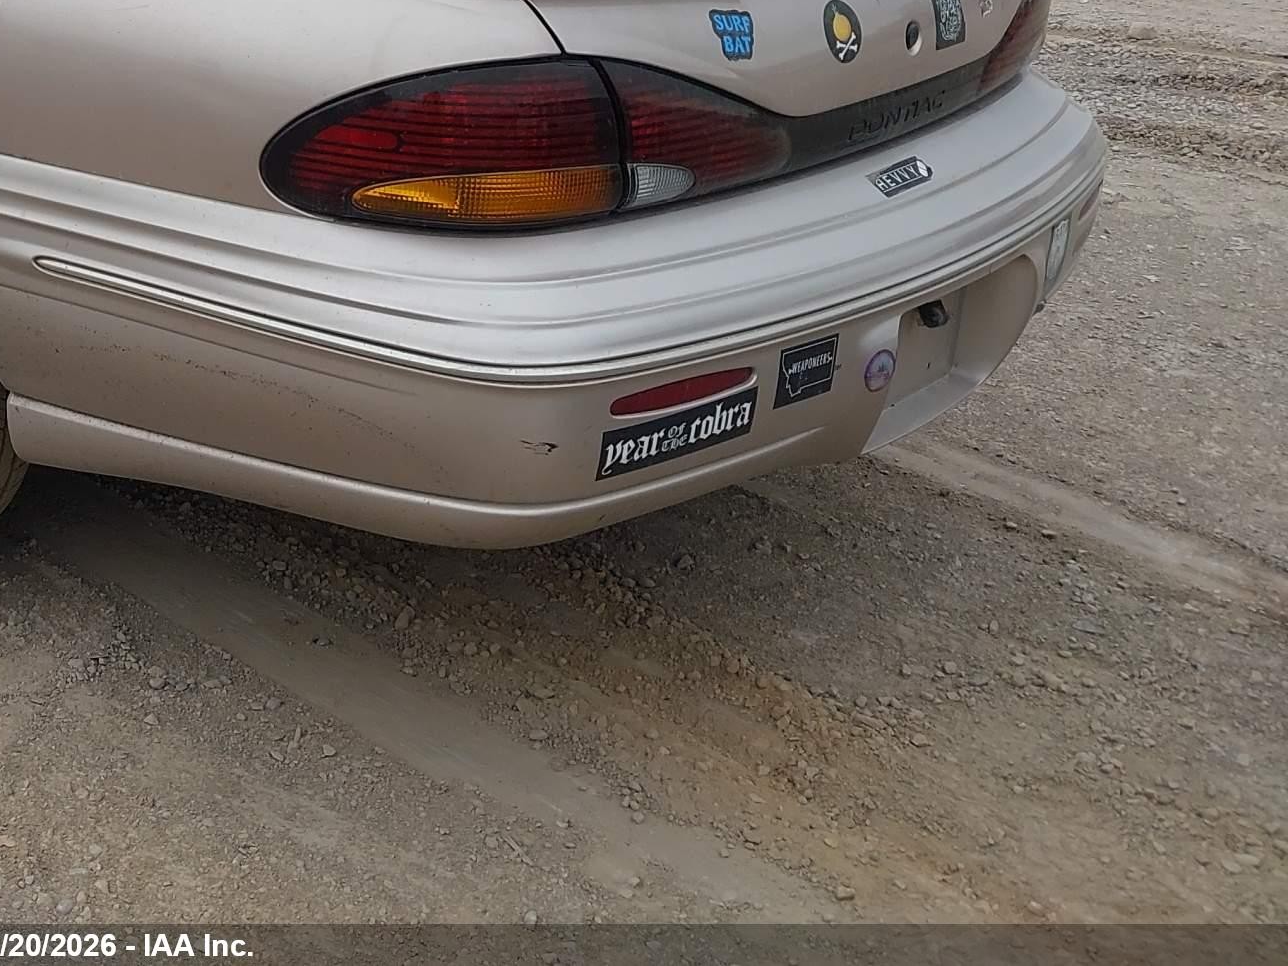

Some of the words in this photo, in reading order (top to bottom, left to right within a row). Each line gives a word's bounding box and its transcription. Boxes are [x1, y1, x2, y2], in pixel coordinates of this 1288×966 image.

[713, 14, 750, 33] SURF
[723, 35, 751, 53] BAT
[847, 89, 945, 141] PONTIAC
[789, 351, 833, 375] WEAPONEERS
[601, 427, 666, 476] year
[687, 400, 754, 445] cobra
